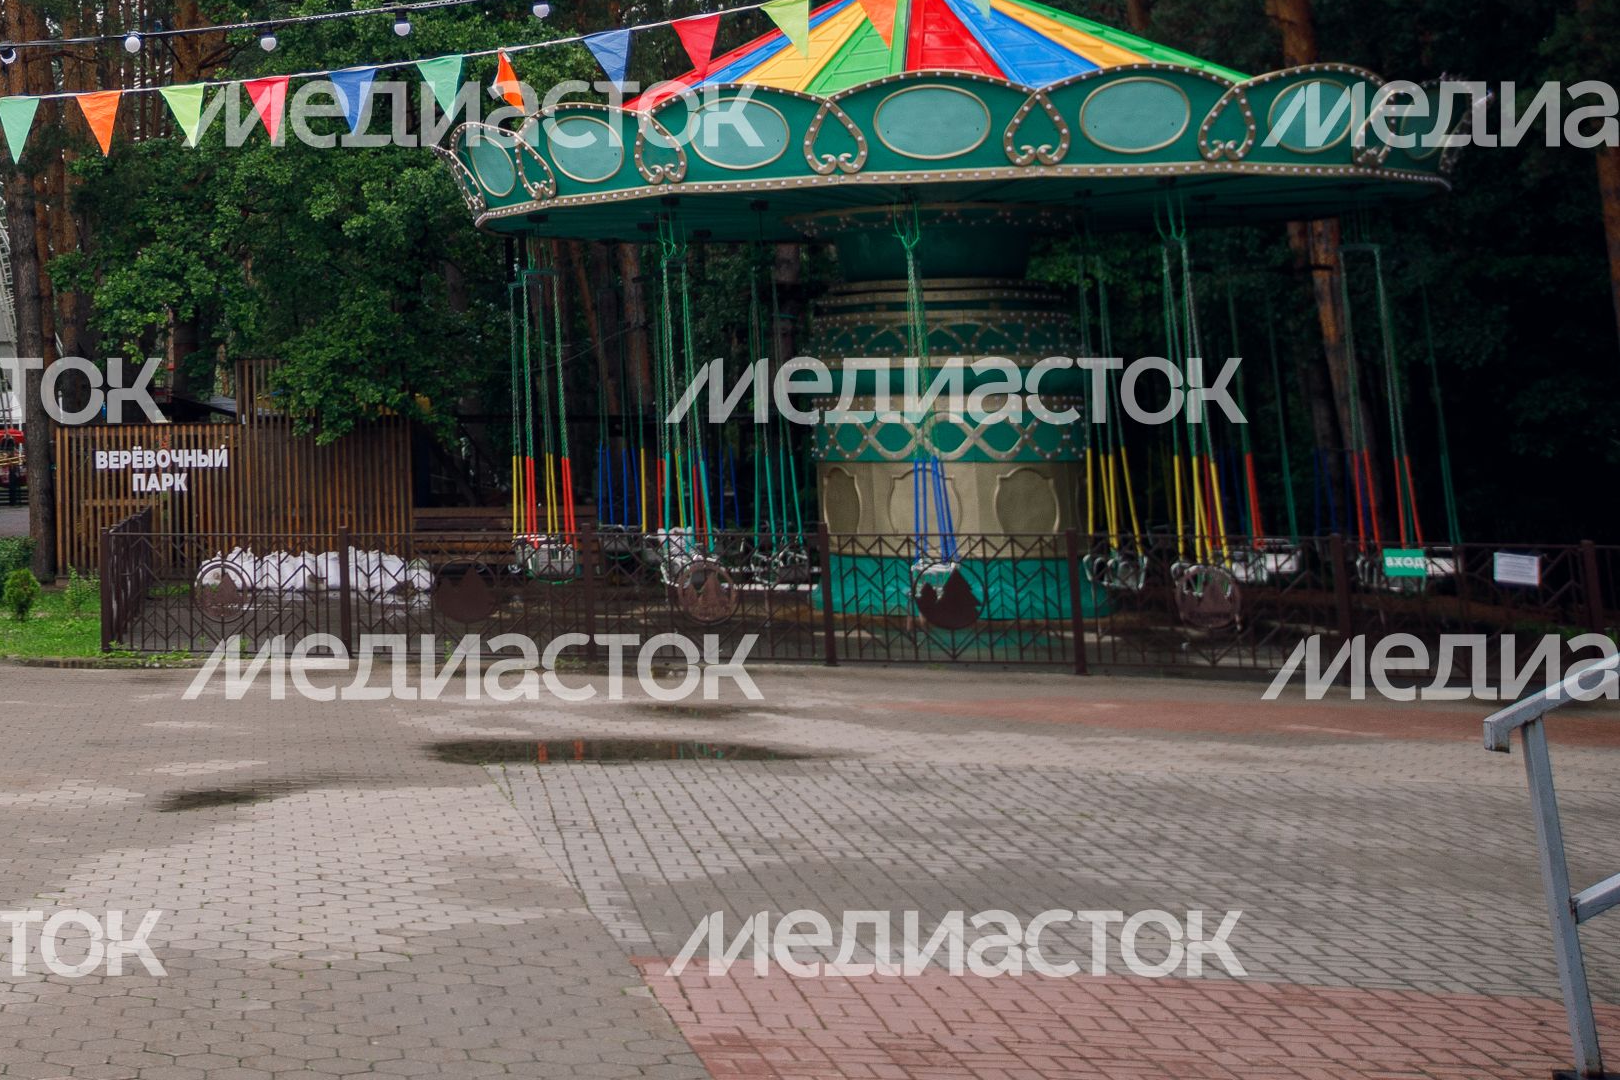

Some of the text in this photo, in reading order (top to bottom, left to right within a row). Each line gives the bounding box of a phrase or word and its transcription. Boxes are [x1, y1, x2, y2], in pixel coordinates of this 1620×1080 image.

[95, 444, 228, 469] ВЕРЁВОЧНЫЙ
[132, 473, 188, 491] ПАРК
[1385, 556, 1425, 569] ВХОД
